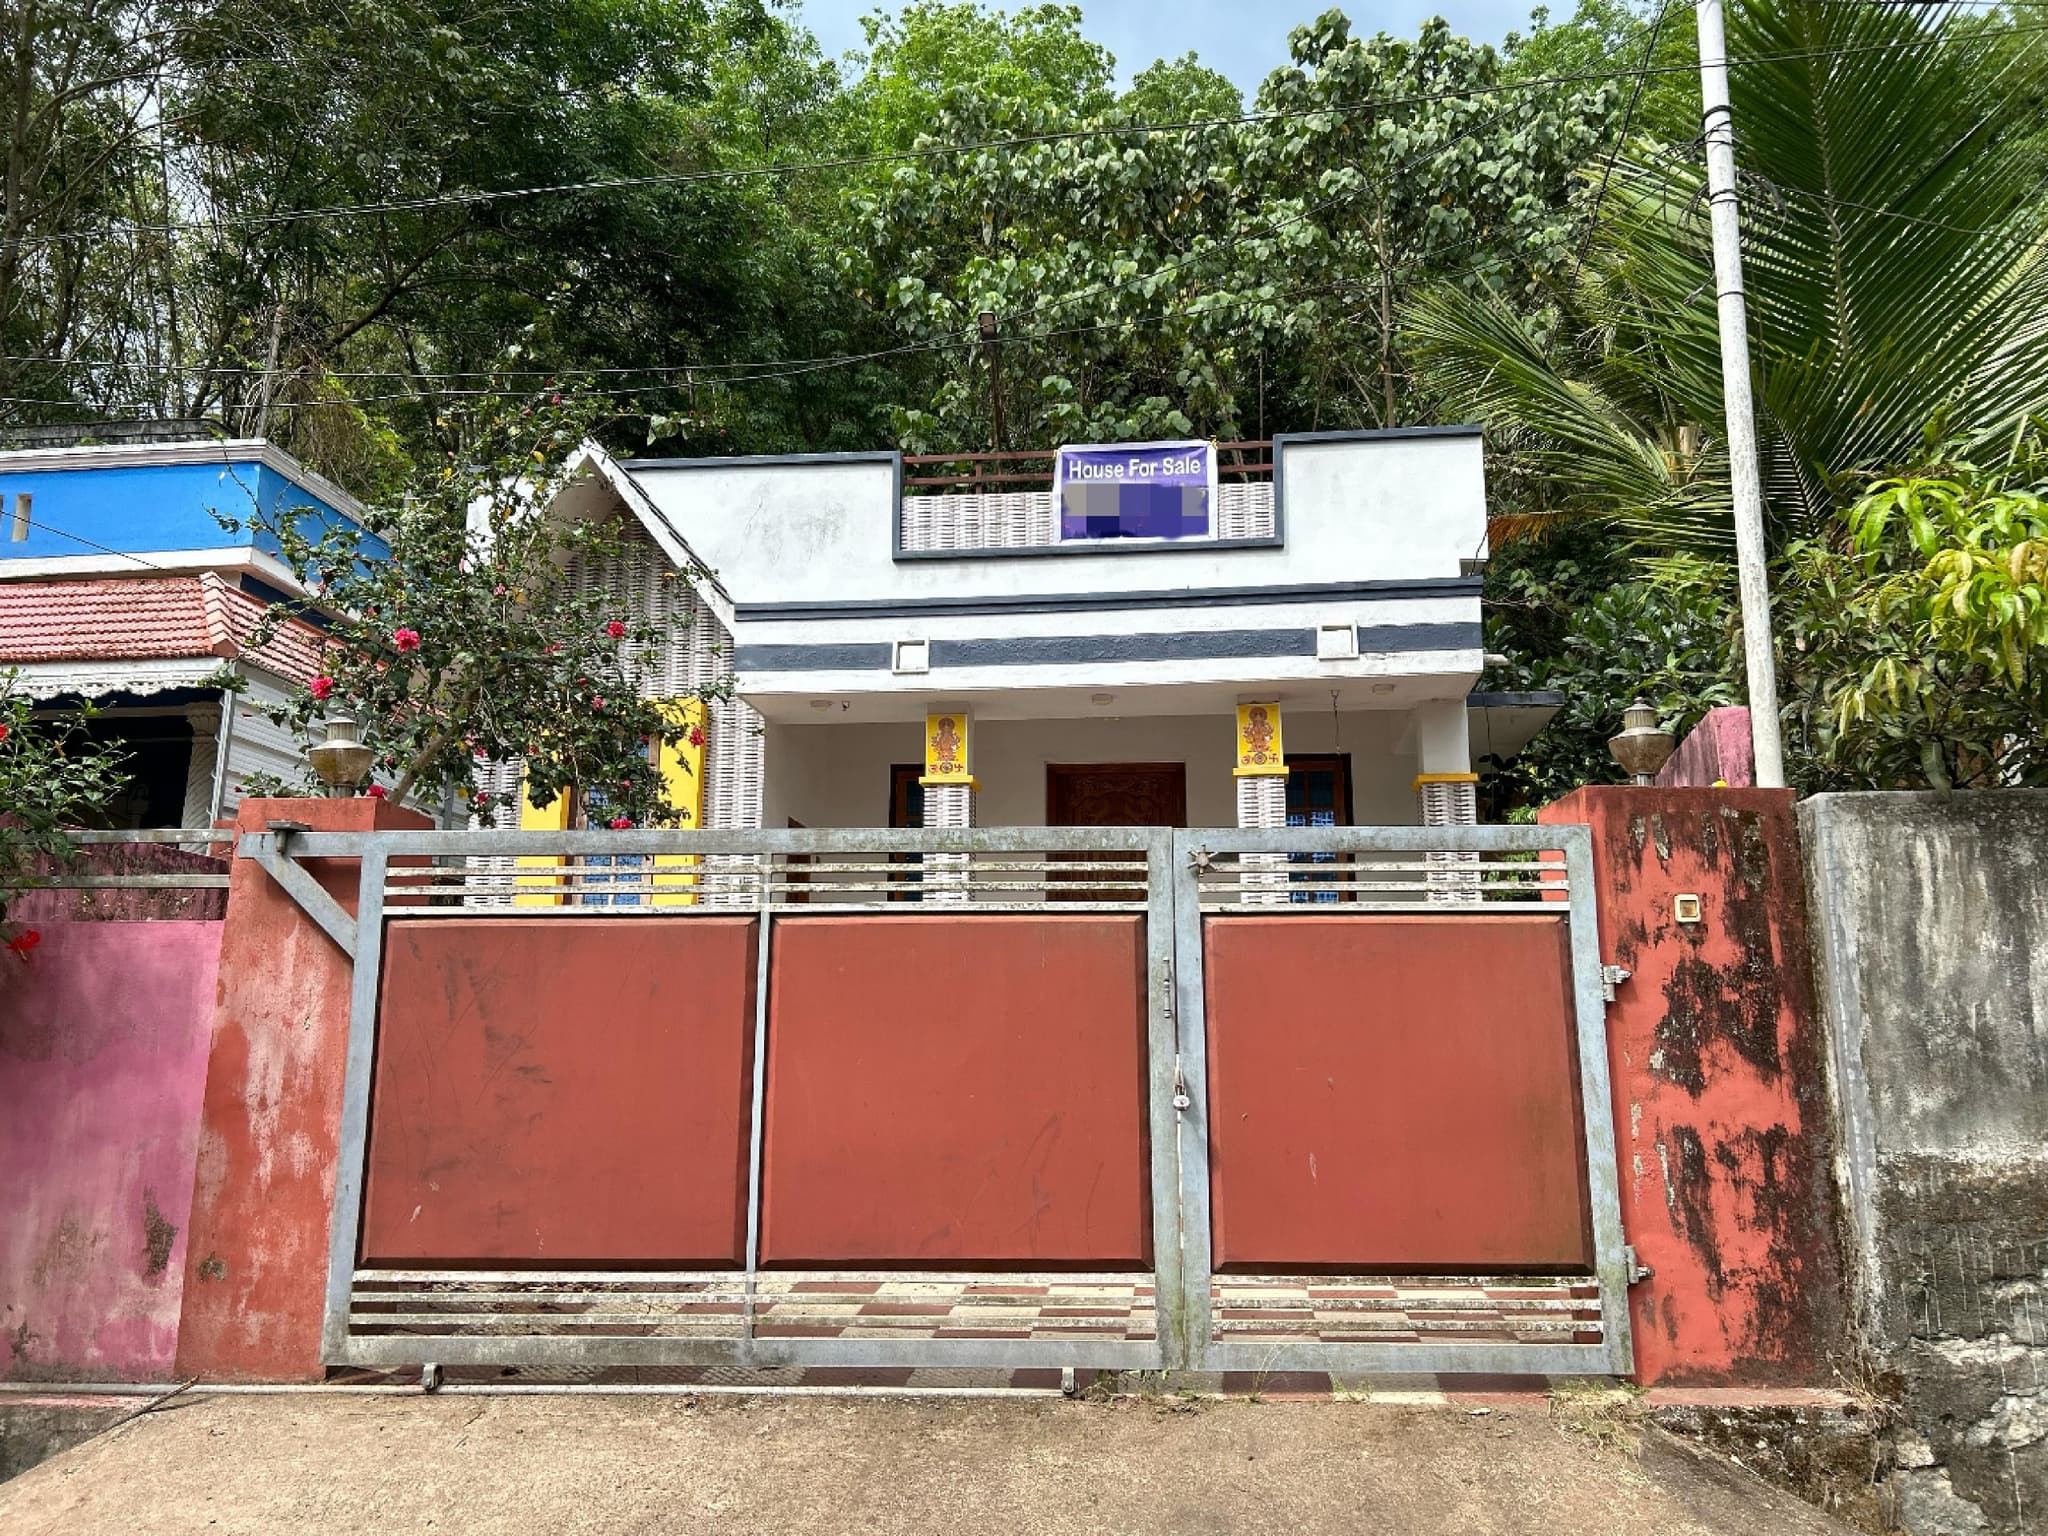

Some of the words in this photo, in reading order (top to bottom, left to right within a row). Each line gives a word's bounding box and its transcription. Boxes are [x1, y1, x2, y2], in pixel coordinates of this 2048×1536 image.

[1069, 460, 1124, 479] House
[1128, 458, 1158, 477] For
[1162, 456, 1201, 476] Sale
